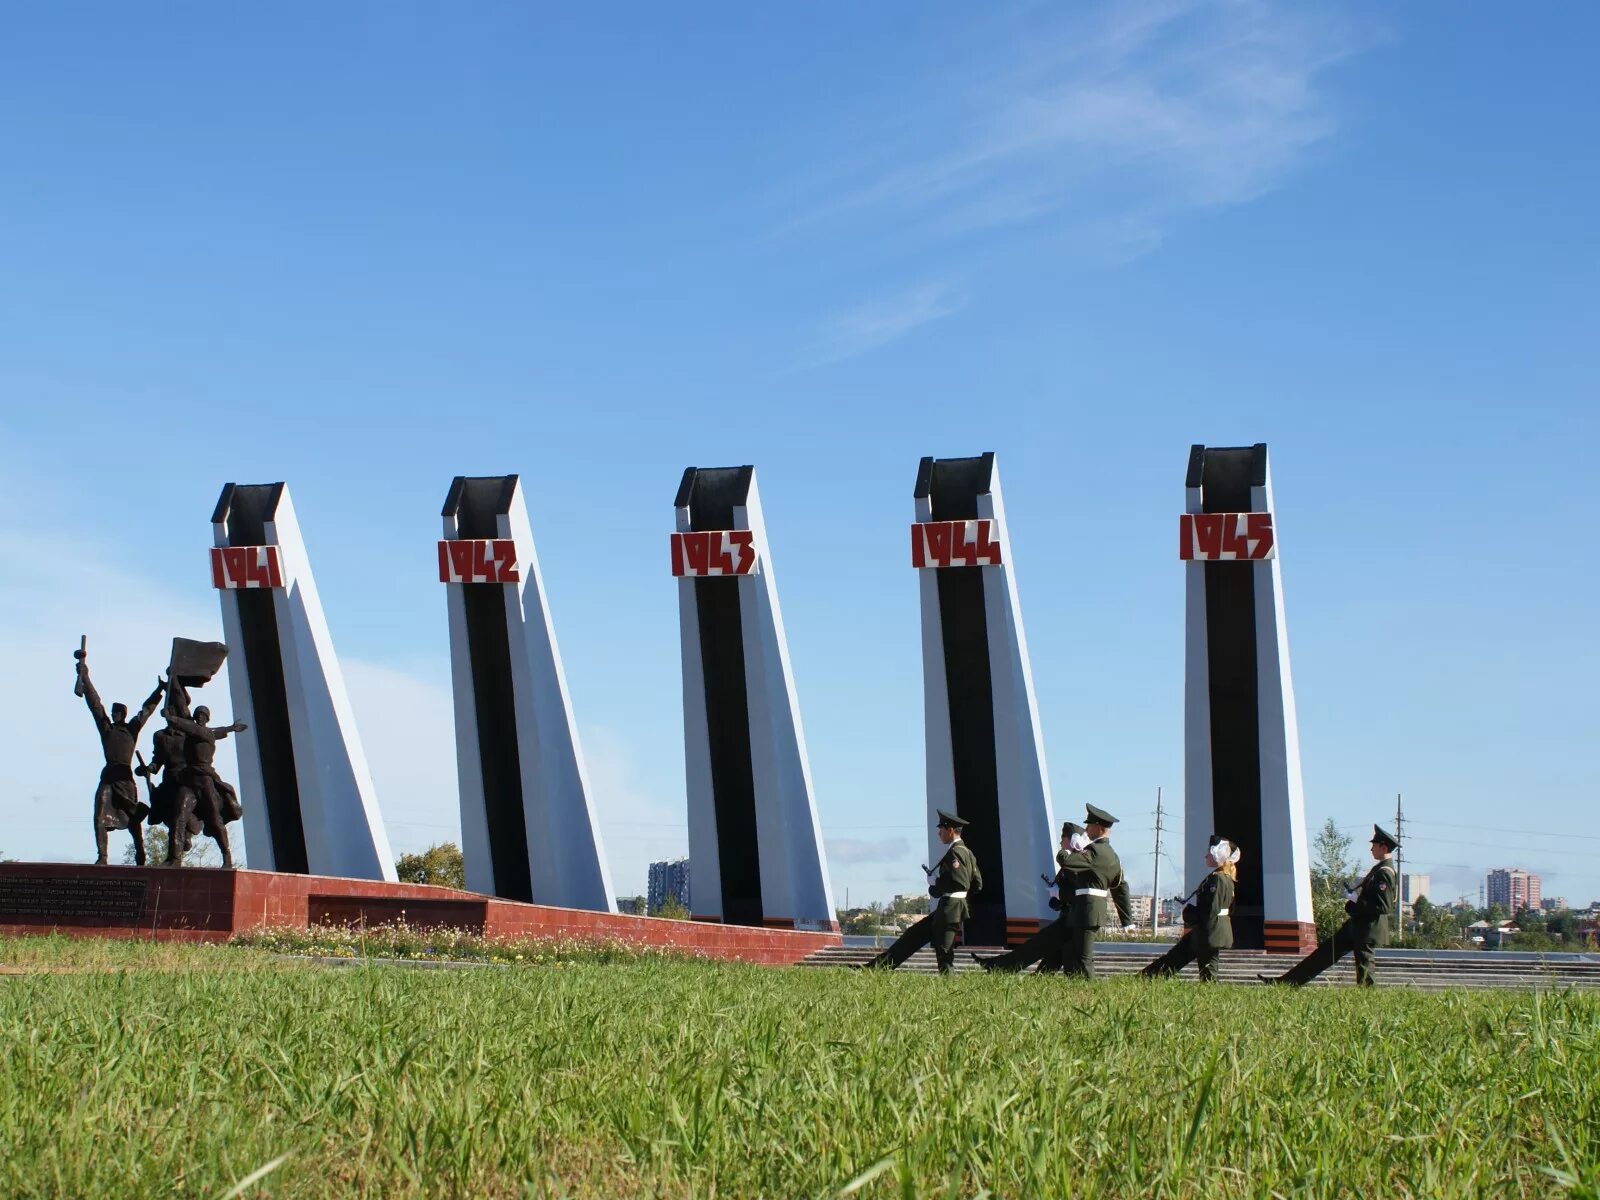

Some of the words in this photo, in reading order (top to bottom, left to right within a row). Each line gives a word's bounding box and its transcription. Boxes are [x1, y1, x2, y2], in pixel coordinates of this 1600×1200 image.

[670, 531, 757, 576] 1943
[911, 521, 1001, 568] 1944
[1180, 513, 1274, 560] 1945
[211, 546, 282, 588] 1941
[438, 540, 520, 582] 1942
